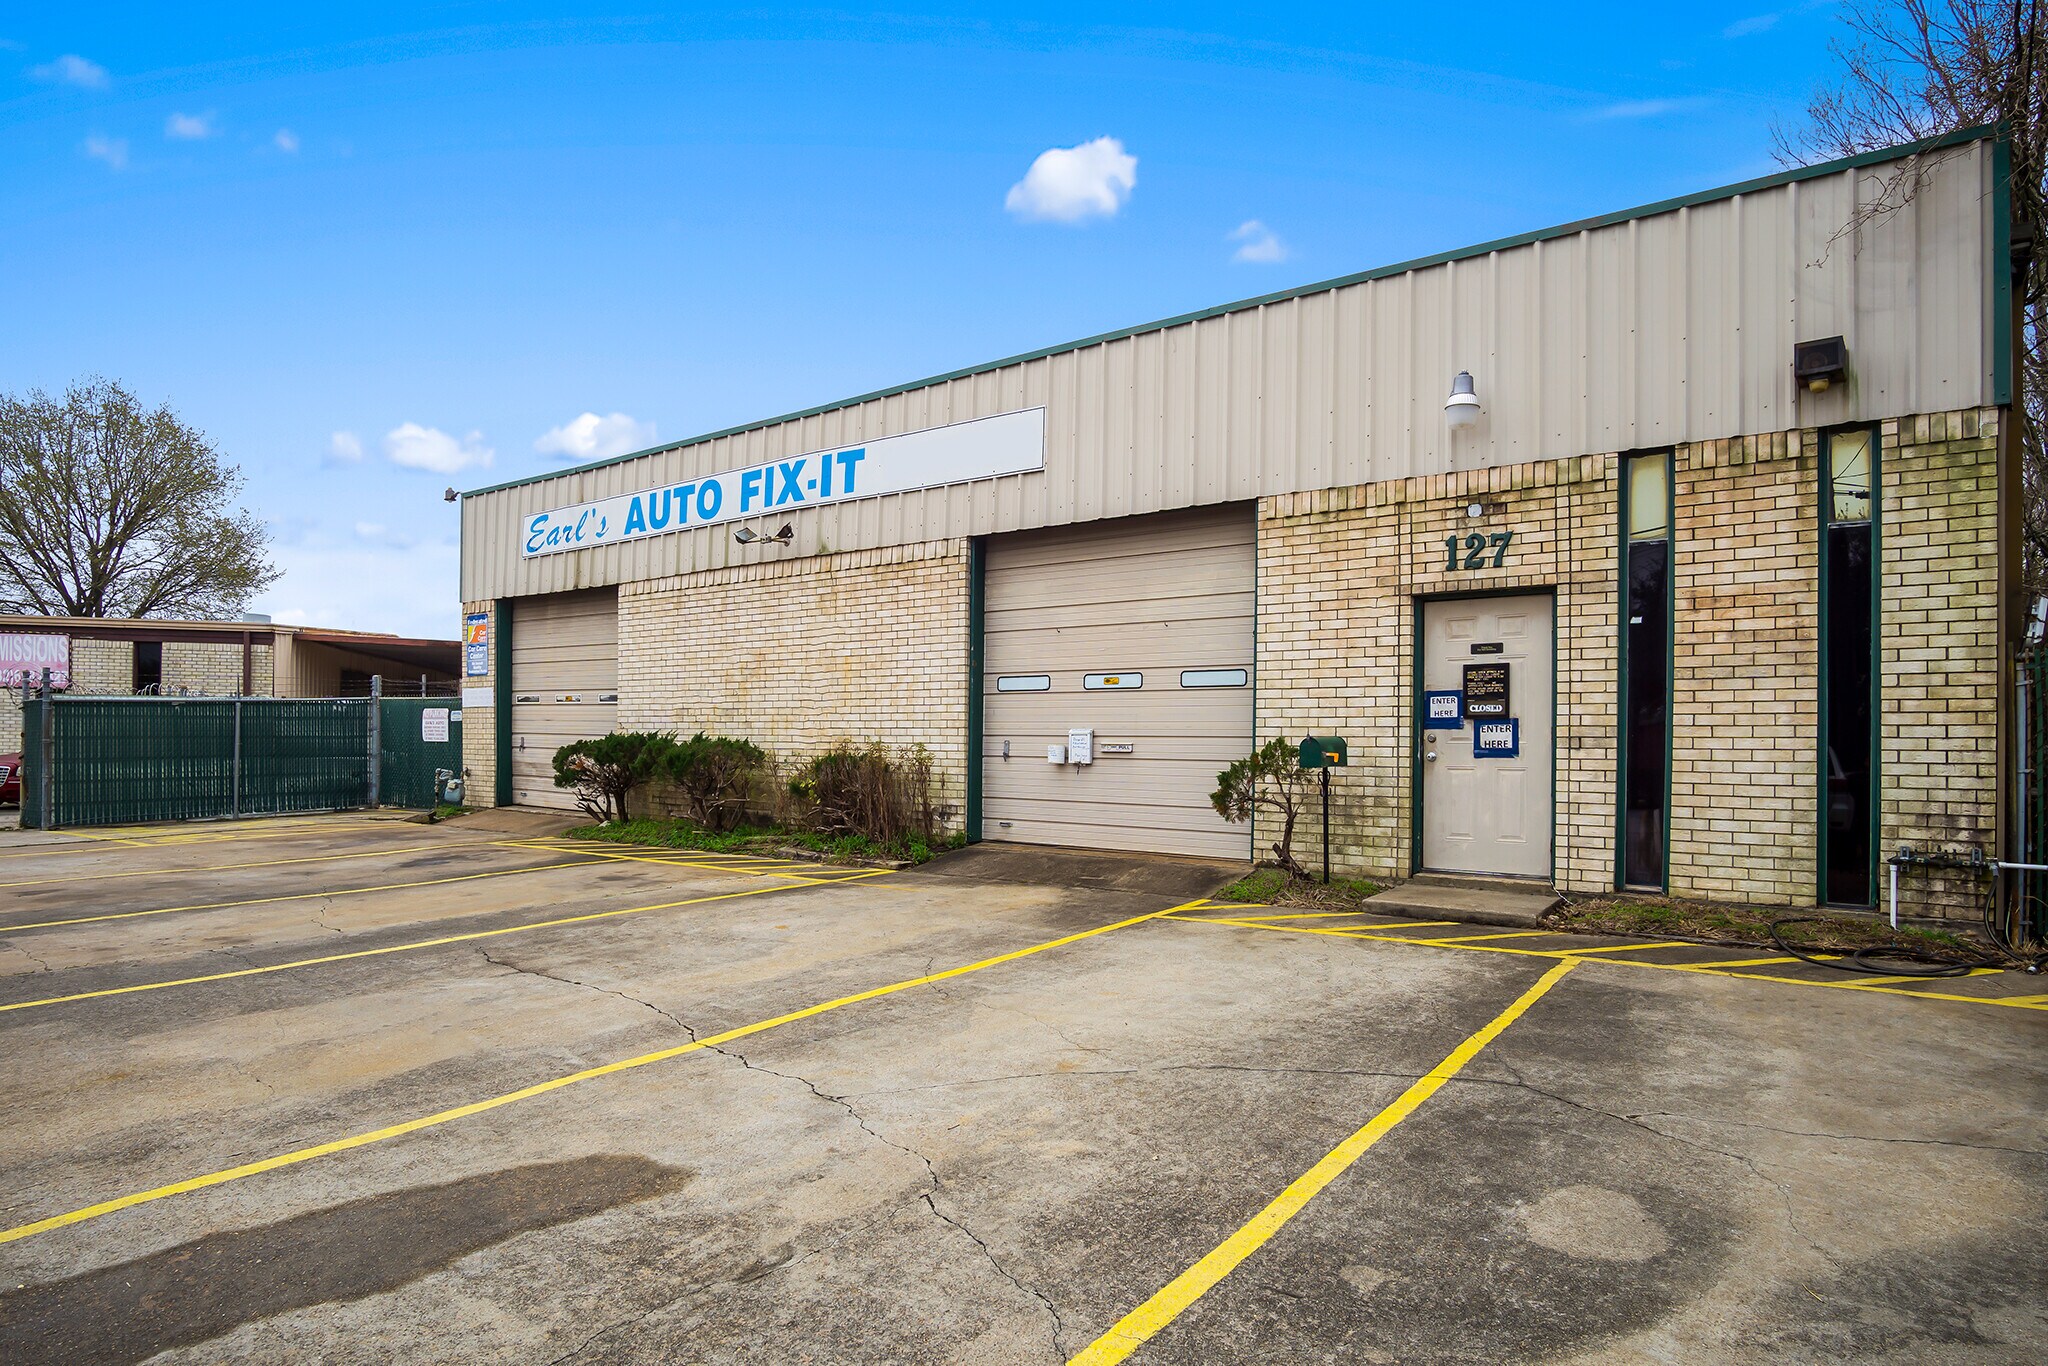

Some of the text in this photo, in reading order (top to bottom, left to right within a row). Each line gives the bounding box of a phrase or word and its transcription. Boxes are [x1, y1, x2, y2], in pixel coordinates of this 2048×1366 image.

[526, 448, 865, 553] Earl's AUTO FIX-IT
[1445, 530, 1514, 571] 127
[1431, 697, 1457, 705] ENTER
[1469, 704, 1503, 712] CLOSED
[1481, 725, 1512, 733] ENTER
[1484, 740, 1509, 748] HERE
